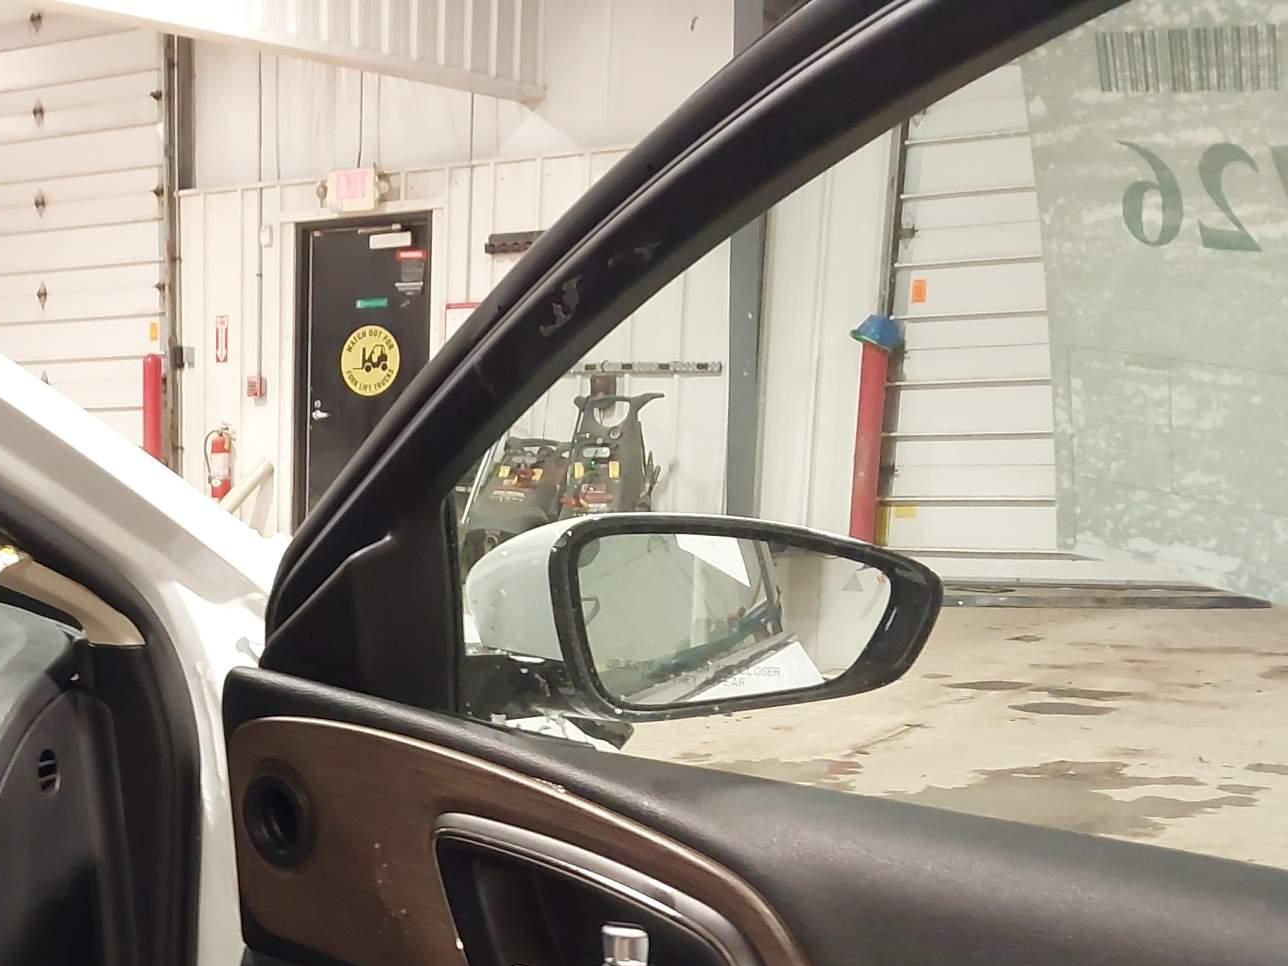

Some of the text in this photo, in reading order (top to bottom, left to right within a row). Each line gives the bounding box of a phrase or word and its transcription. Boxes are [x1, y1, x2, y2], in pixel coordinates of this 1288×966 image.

[346, 329, 394, 352] WATCH OUT FOR
[346, 369, 394, 392] FORK LIFT TRUCKS
